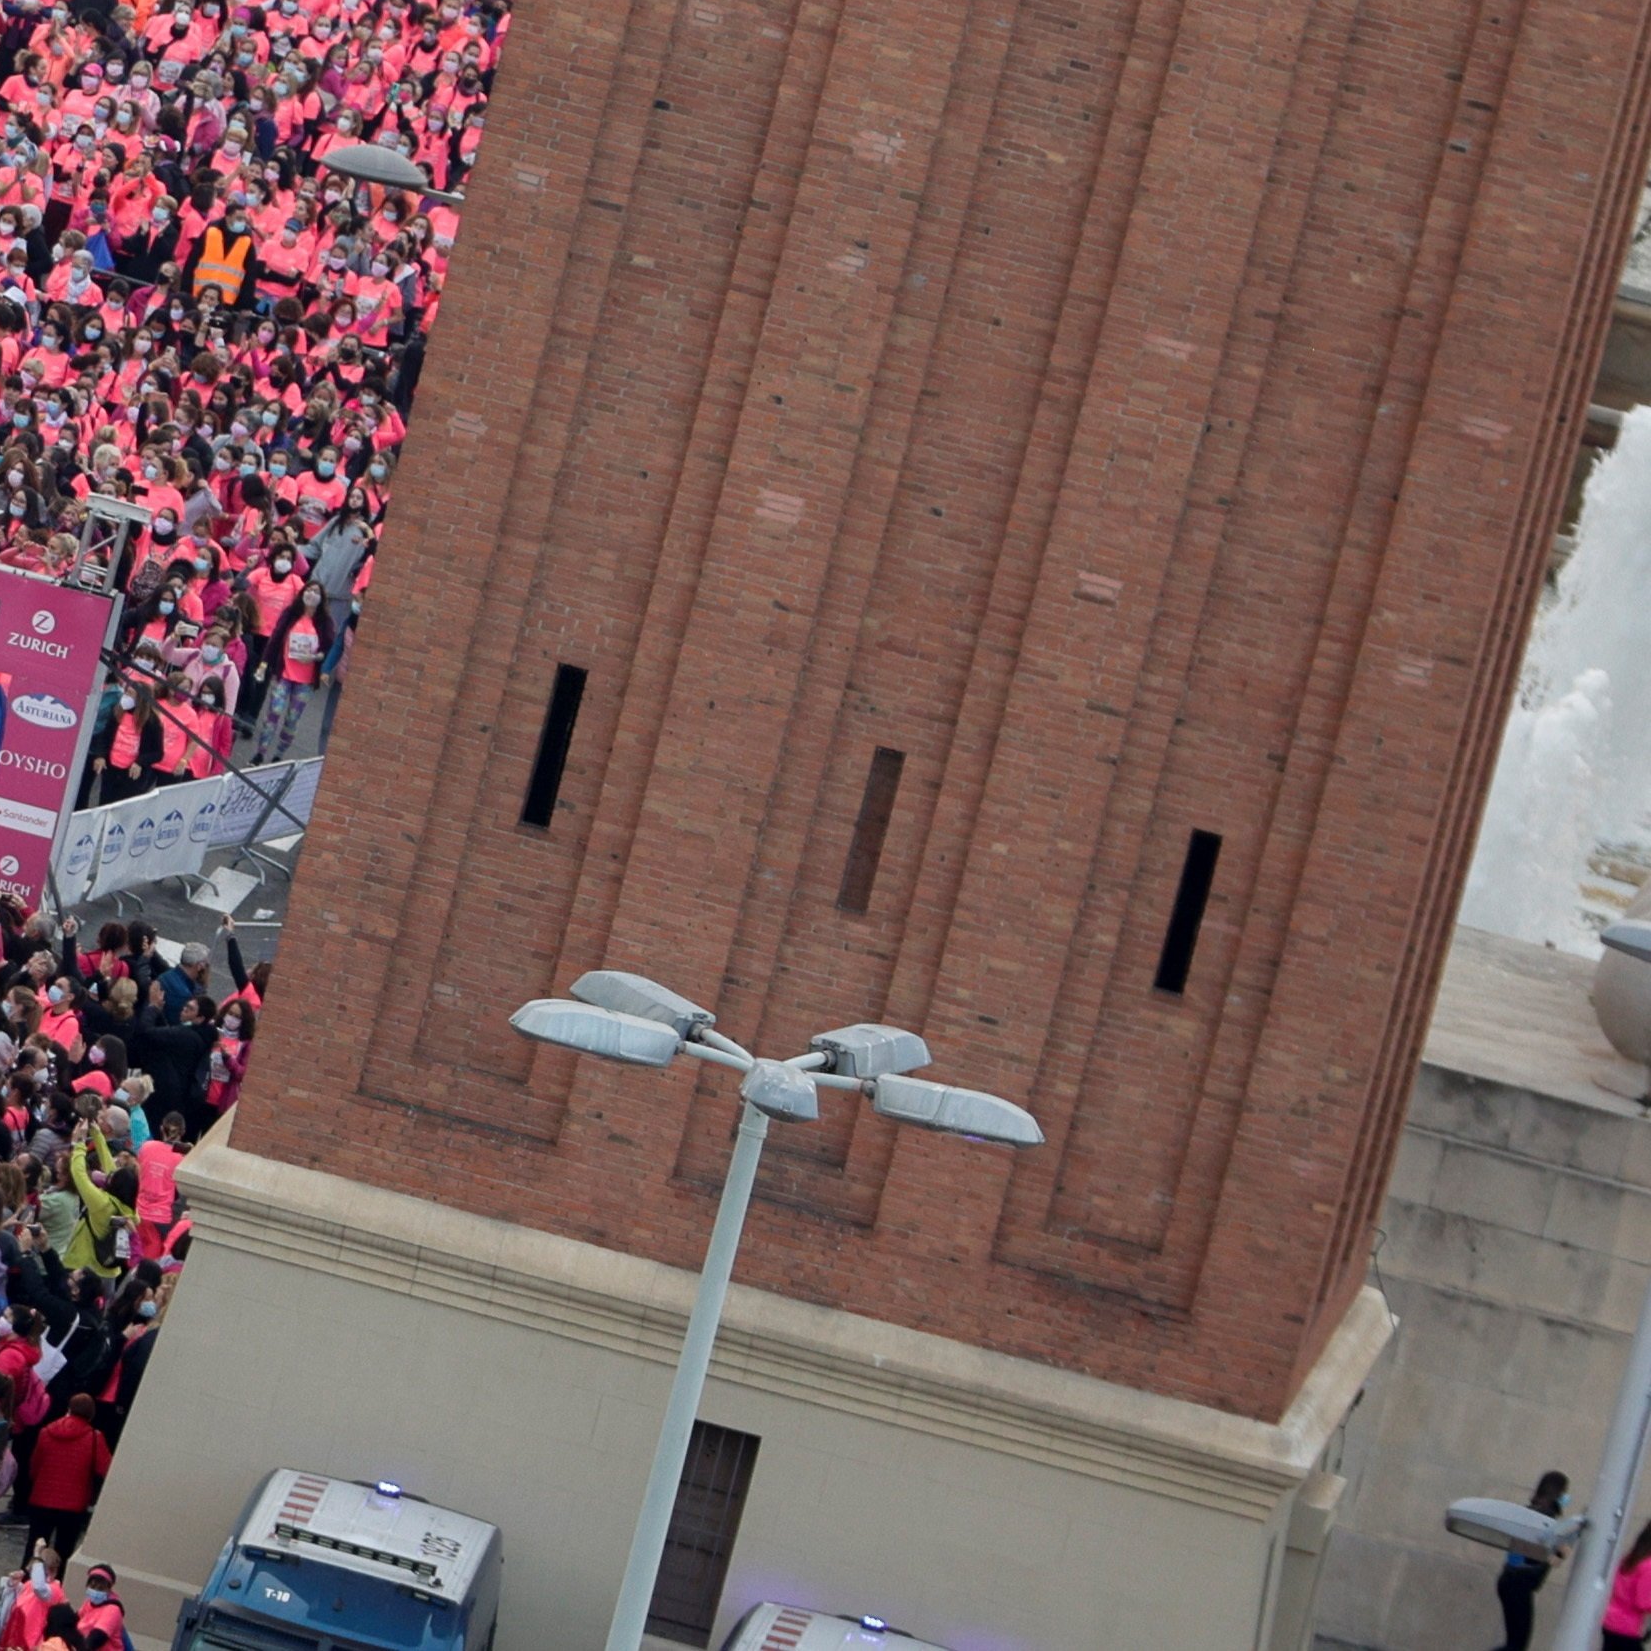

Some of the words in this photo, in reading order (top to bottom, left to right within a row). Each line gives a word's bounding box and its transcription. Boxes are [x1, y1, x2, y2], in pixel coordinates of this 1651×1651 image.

[7, 631, 68, 659] ZURICH
[16, 700, 72, 725] ASTURIANA
[3, 808, 49, 827] Santander
